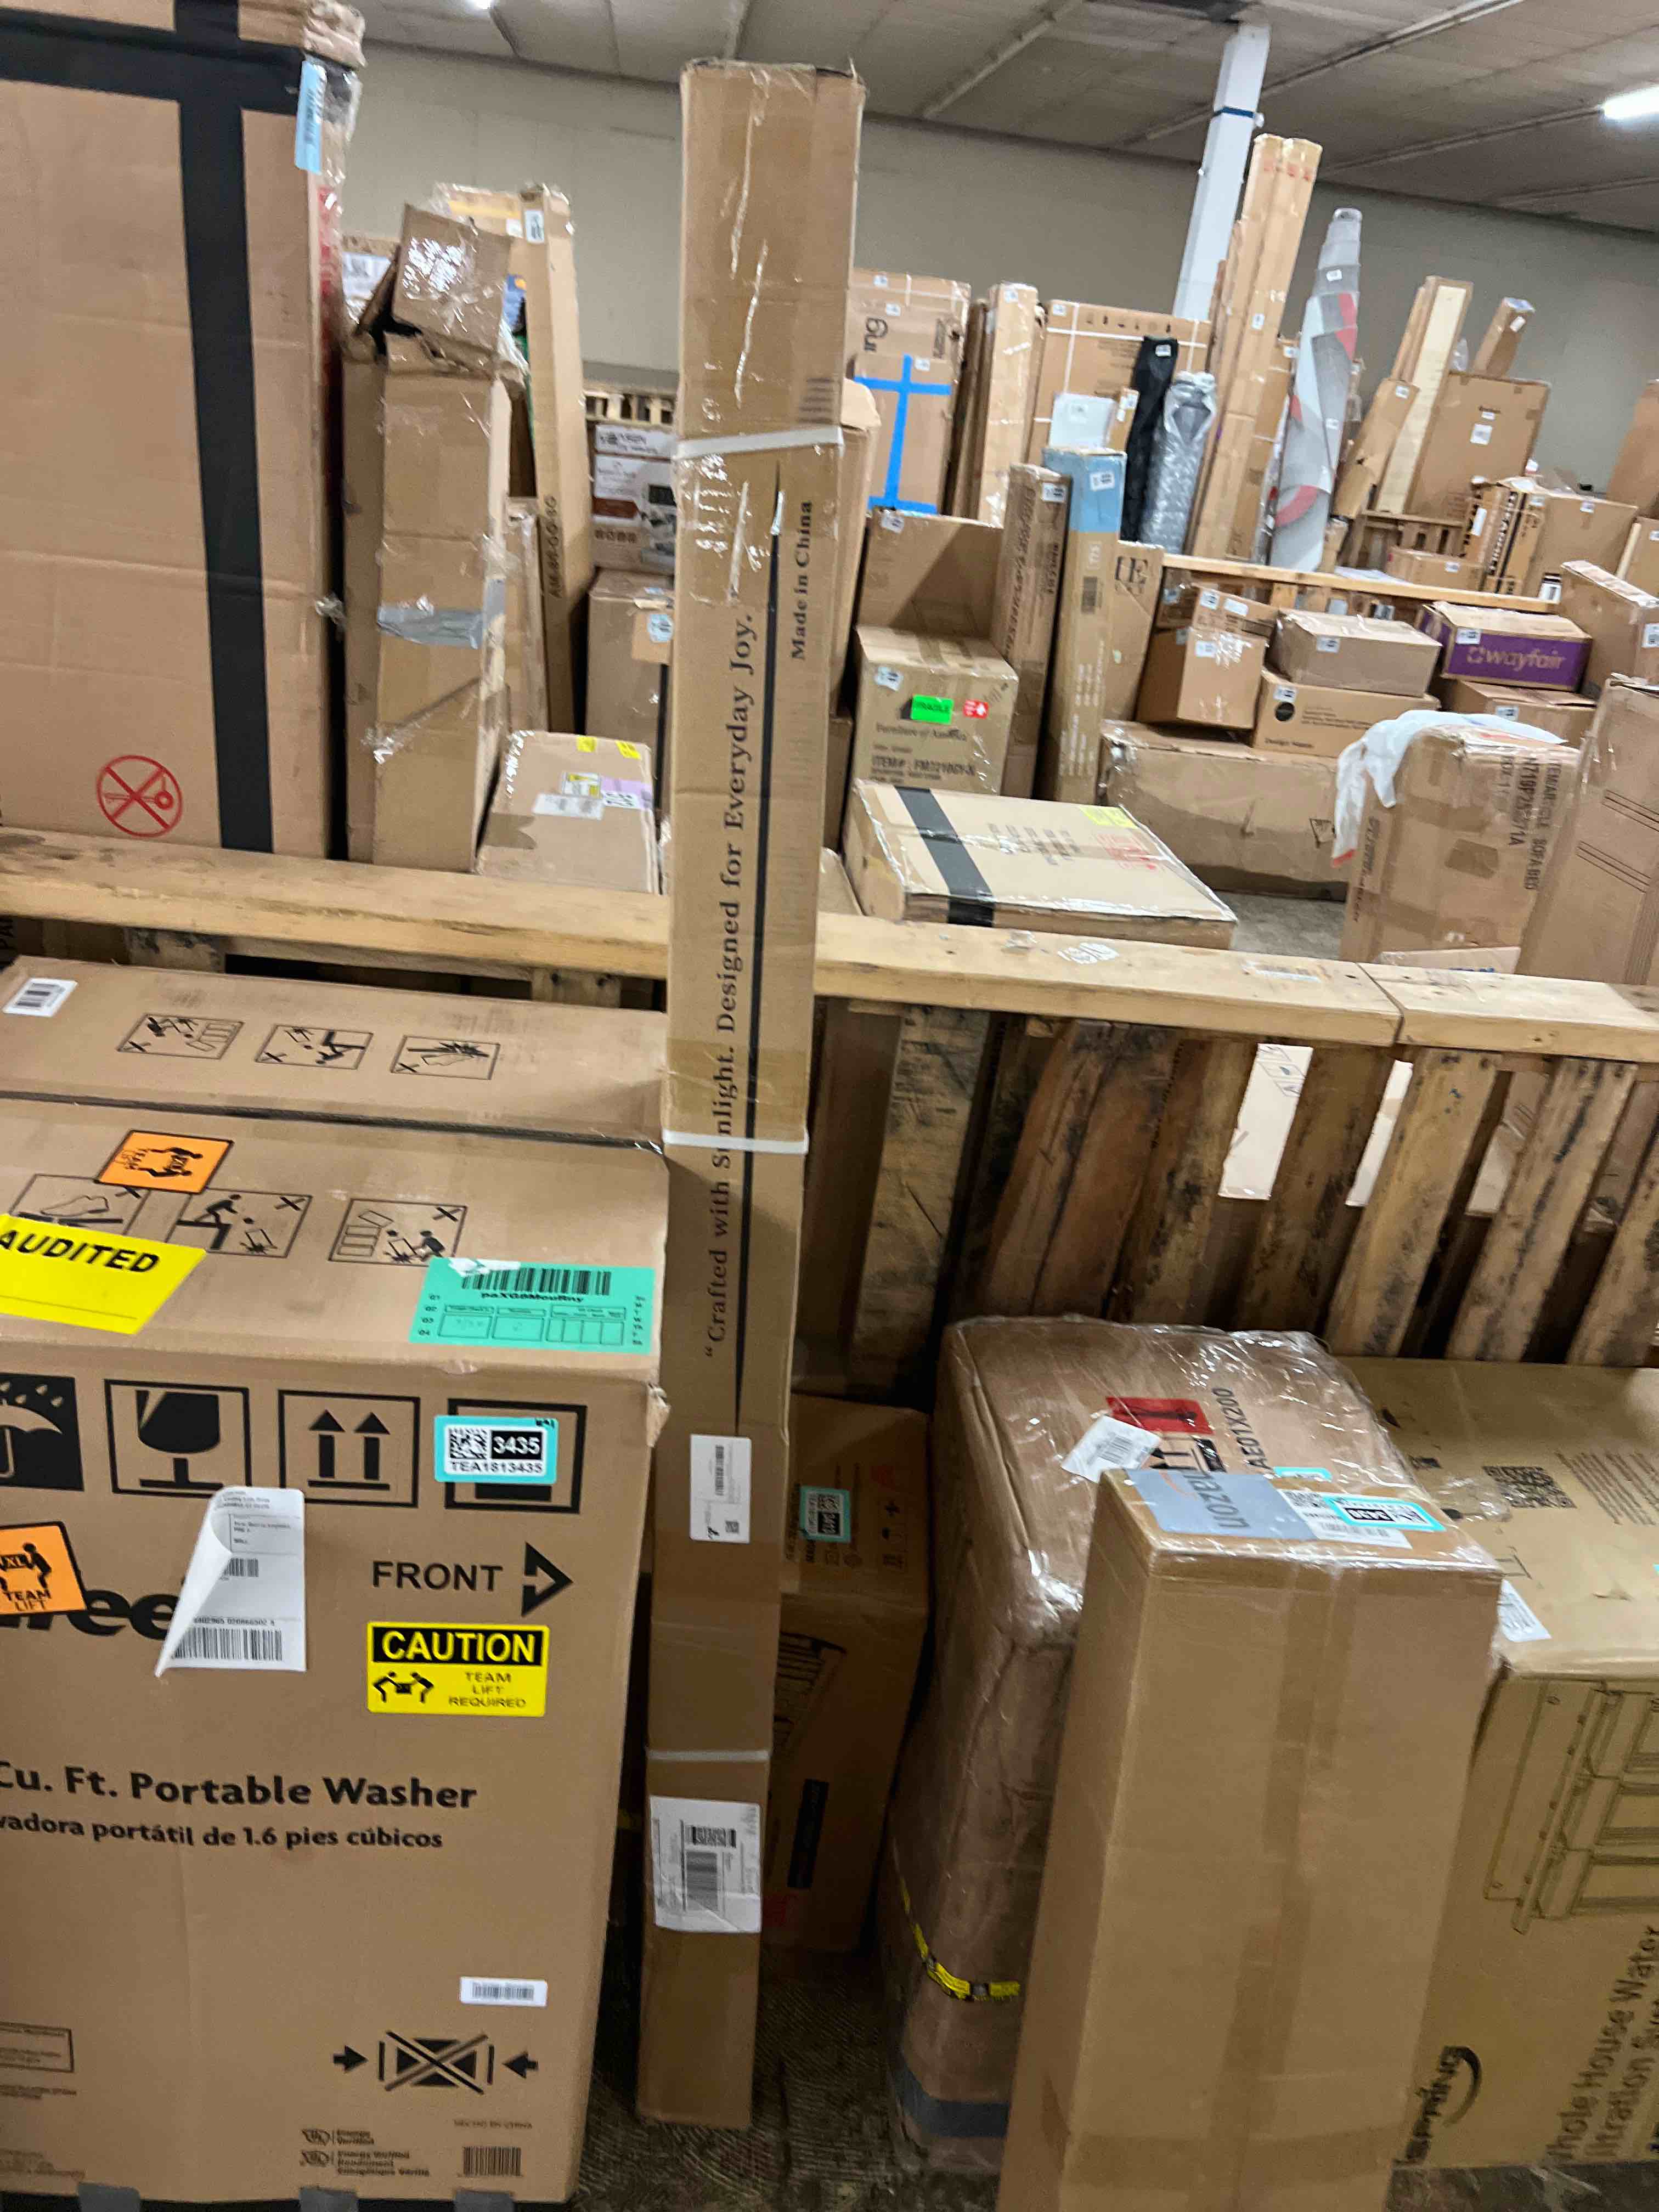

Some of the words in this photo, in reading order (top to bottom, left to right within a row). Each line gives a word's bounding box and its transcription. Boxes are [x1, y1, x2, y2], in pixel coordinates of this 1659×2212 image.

[795, 500, 812, 568] China
[794, 575, 808, 595] in
[729, 614, 758, 676] Joy.
[791, 599, 808, 661] Made
[1486, 648, 1566, 672] wayfair
[724, 685, 755, 831] Everyday
[720, 843, 743, 888] for
[716, 901, 743, 1034] Designed
[712, 1046, 738, 1170] Snlight.
[710, 1181, 730, 1237] with
[0, 1229, 160, 1273] AUDITED
[493, 1435, 540, 1454] 3435
[6, 1589, 52, 1601] TEAM
[373, 1560, 503, 1592] FRONT
[14, 1599, 47, 1612] LIFT
[382, 1630, 536, 1663] CAUTION
[465, 1672, 511, 1683] TEAM
[472, 1684, 504, 1695] LIFT
[448, 1696, 526, 1708] REQUIRED
[64, 1765, 118, 1798] Ft.
[130, 1771, 312, 1805] Portable
[322, 1776, 477, 1809] Washer
[92, 1821, 194, 1847] portátil
[202, 1826, 236, 1847] de
[243, 1826, 278, 1846] 1.6
[286, 1826, 339, 1850] pies
[346, 1825, 443, 1848] cúbicos
[1572, 2009, 1635, 2088] House
